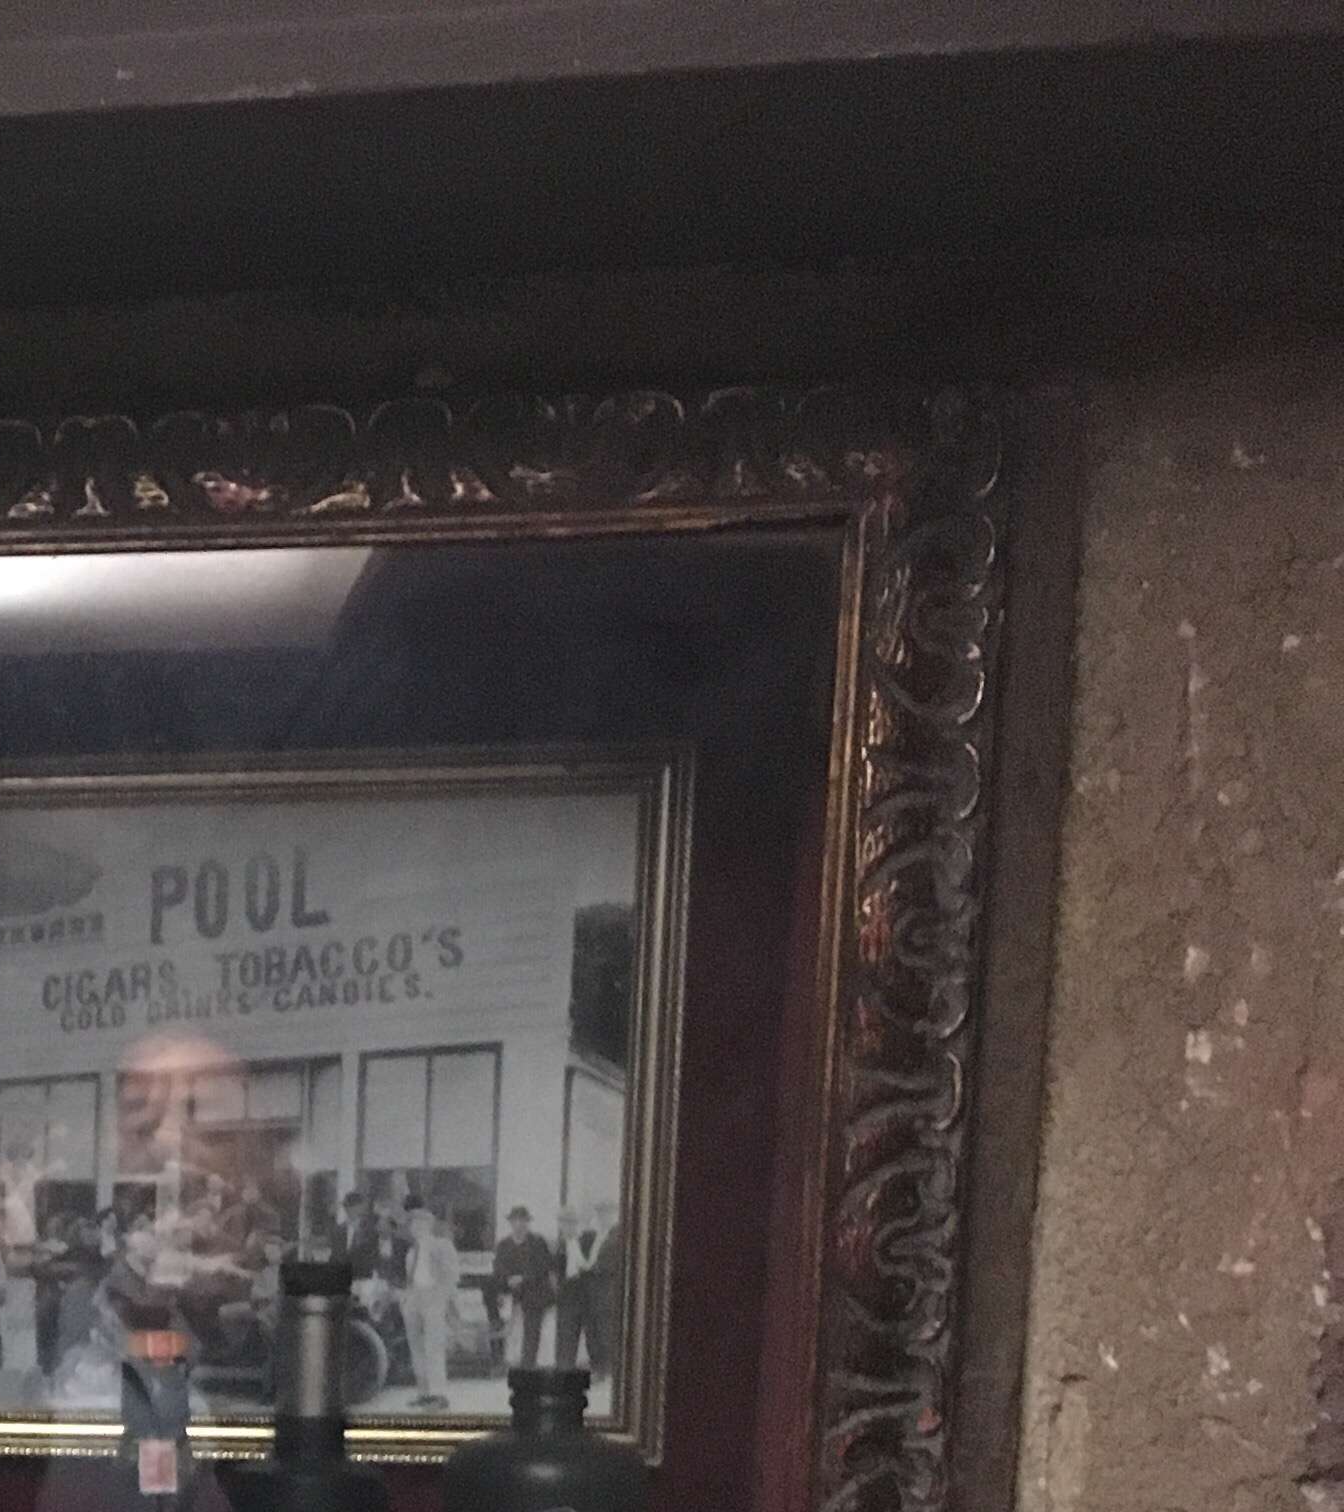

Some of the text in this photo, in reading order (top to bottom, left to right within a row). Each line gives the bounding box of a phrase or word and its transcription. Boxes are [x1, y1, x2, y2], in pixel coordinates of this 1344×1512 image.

[150, 845, 330, 945] POOL
[216, 926, 464, 990] TOBACCO'S
[60, 1003, 127, 1033] COLD
